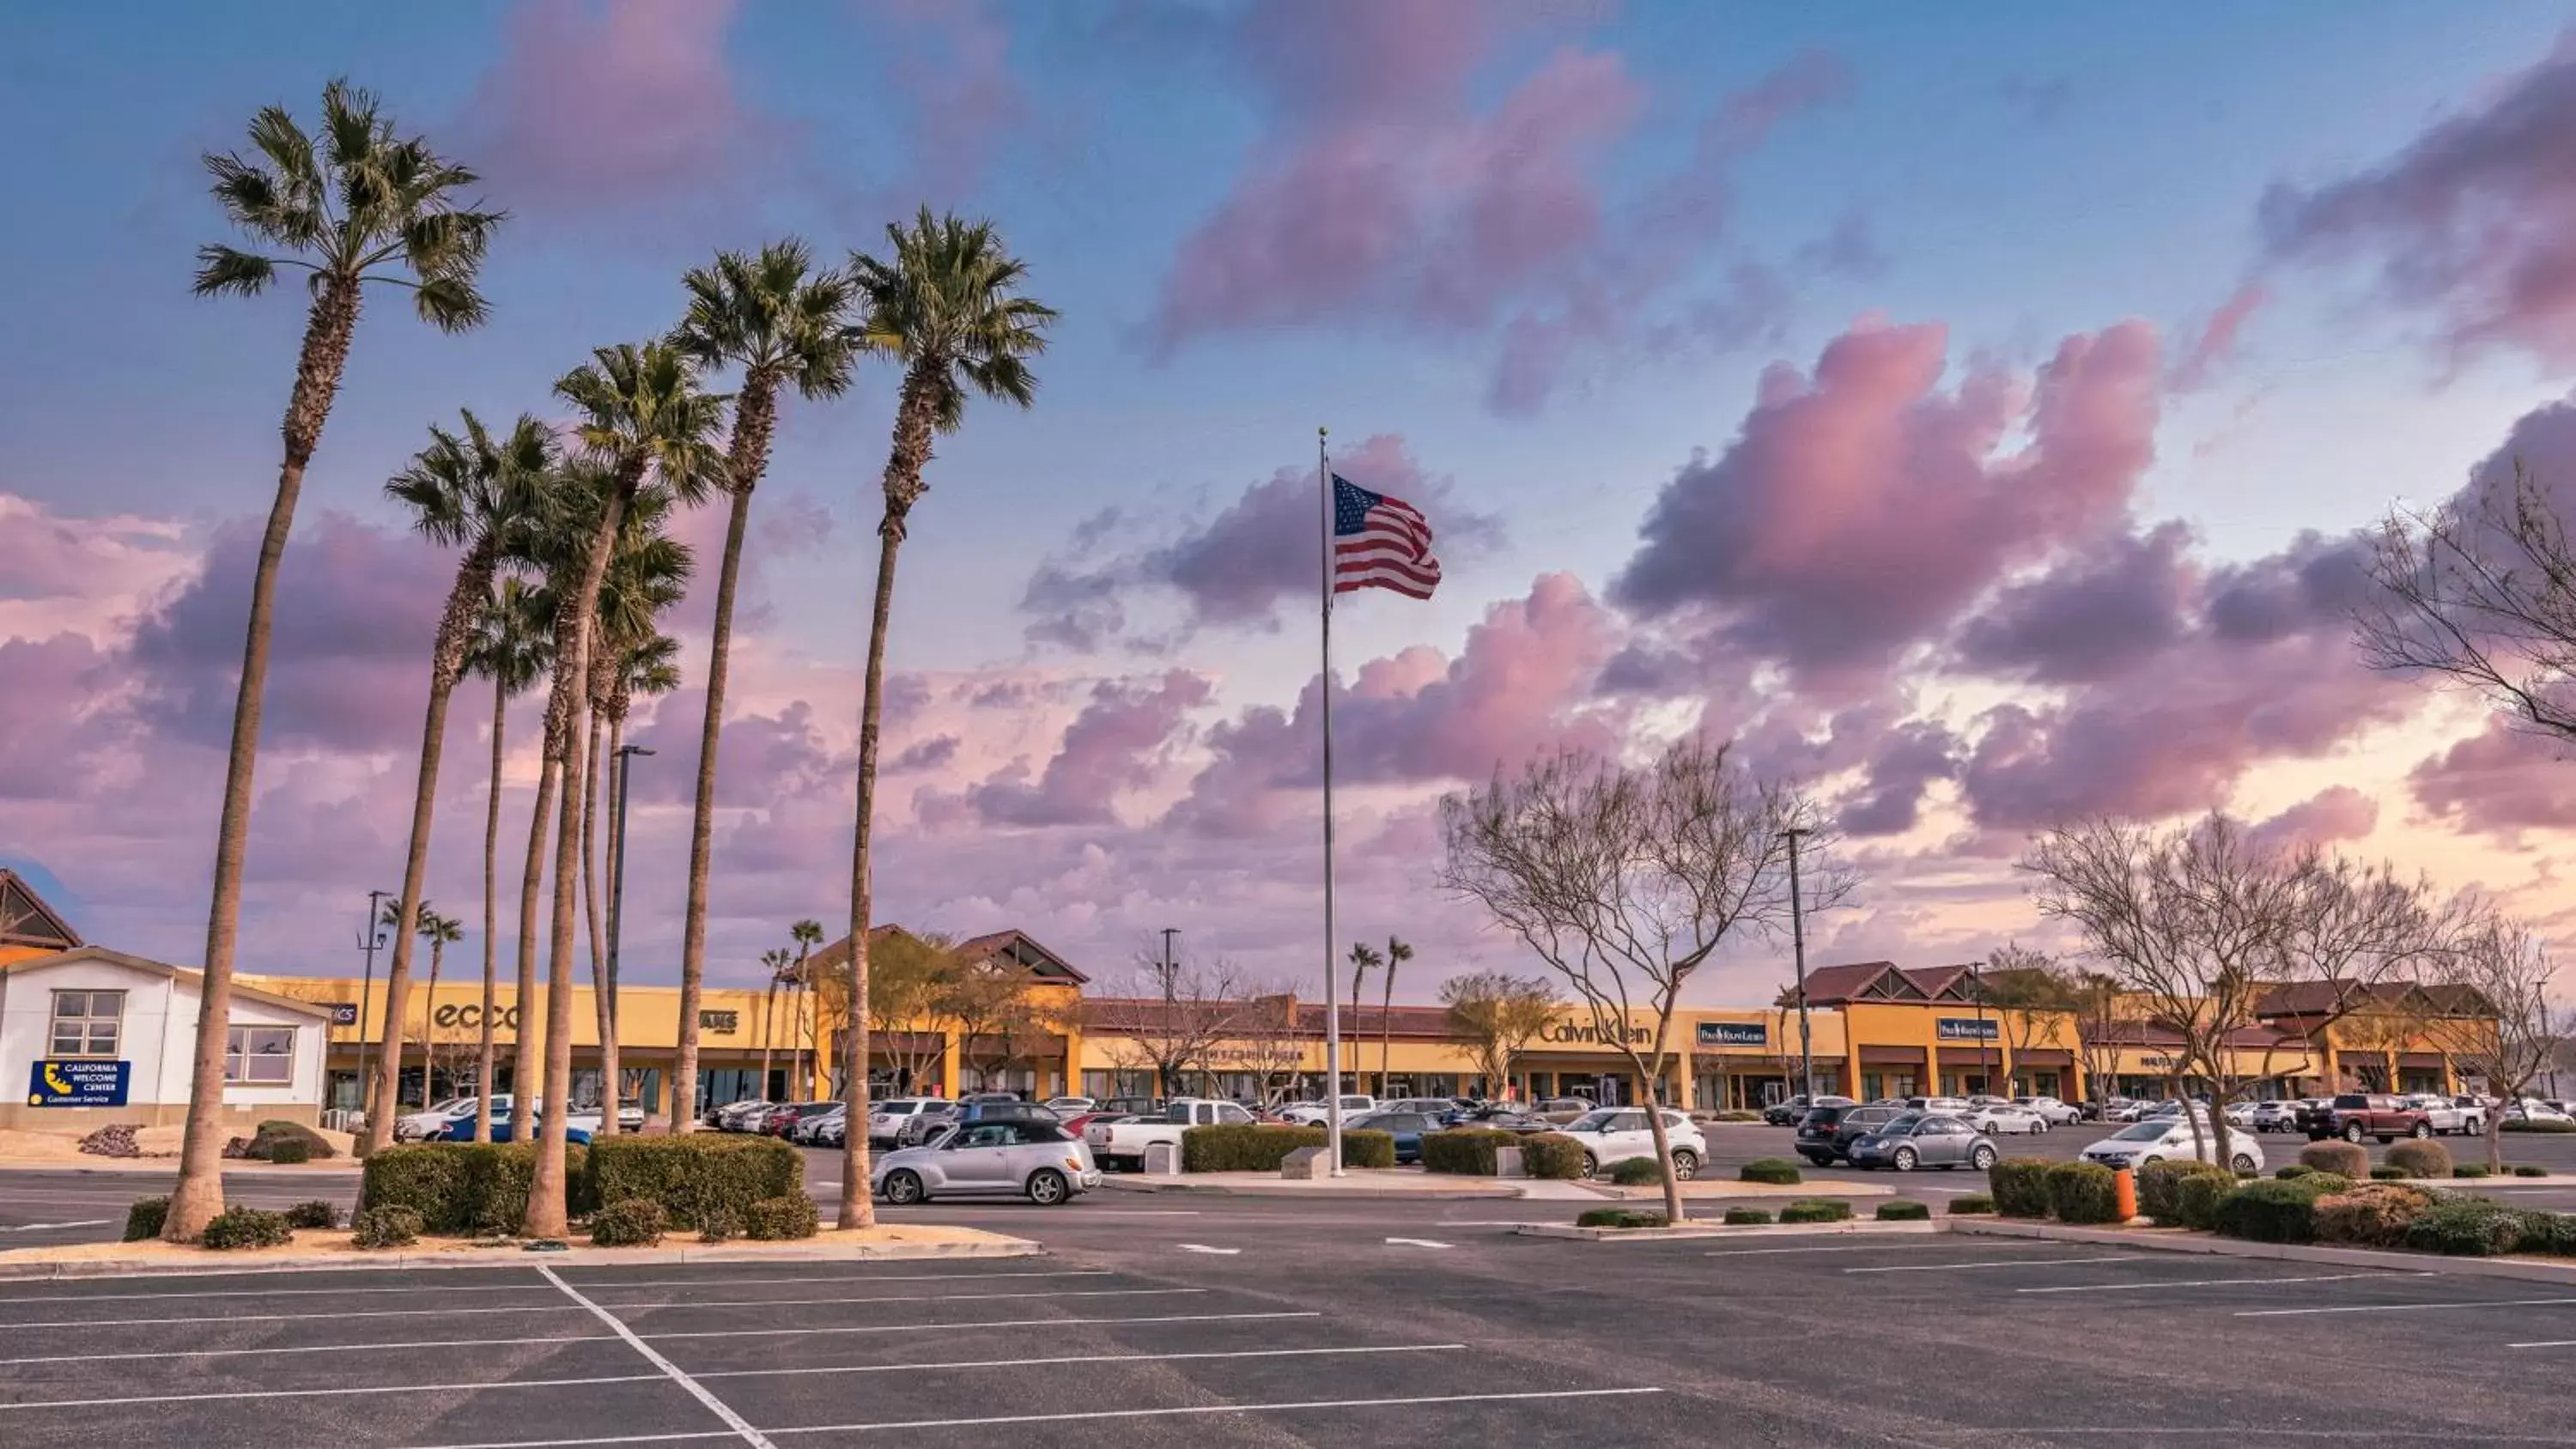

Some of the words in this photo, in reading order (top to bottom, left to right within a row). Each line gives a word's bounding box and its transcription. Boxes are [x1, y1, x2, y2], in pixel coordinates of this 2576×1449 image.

[700, 1010, 738, 1029] ANS
[64, 1064, 118, 1072] CALIFORNIA
[72, 1074, 117, 1082] WELCOME
